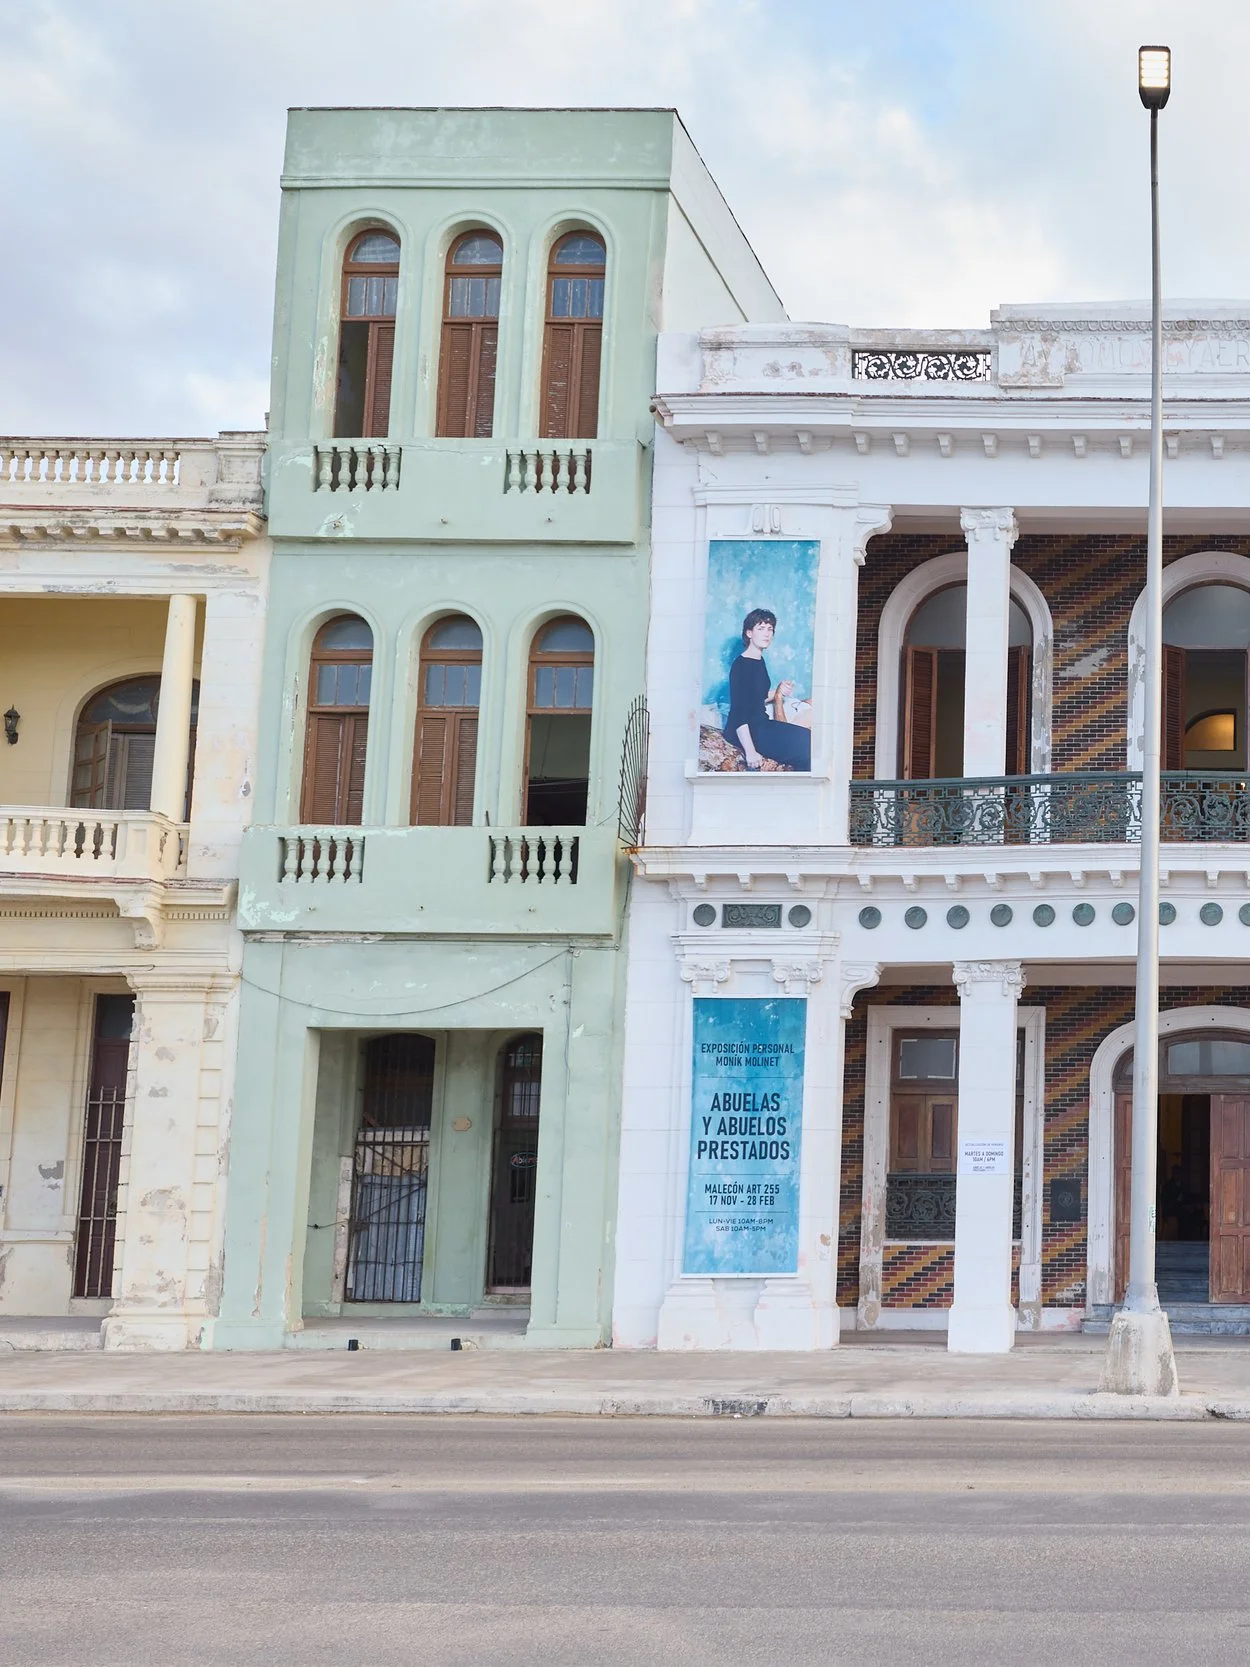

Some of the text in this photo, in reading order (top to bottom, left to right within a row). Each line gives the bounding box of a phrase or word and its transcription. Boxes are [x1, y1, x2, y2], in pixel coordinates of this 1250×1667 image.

[701, 1041, 795, 1054] EXPOSICIÓN PERSONAL
[716, 1054, 780, 1066] MONÍK MOLINET
[710, 1093, 781, 1112] ABUELAS
[702, 1116, 787, 1136] Y ABUELOS
[697, 1140, 790, 1160] PRESTADOS
[704, 1181, 780, 1194] MALECÓN ART 255
[709, 1195, 718, 1205] 17
[721, 1195, 738, 1205] NOV
[747, 1195, 757, 1205] 28
[759, 1195, 775, 1205] FEB
